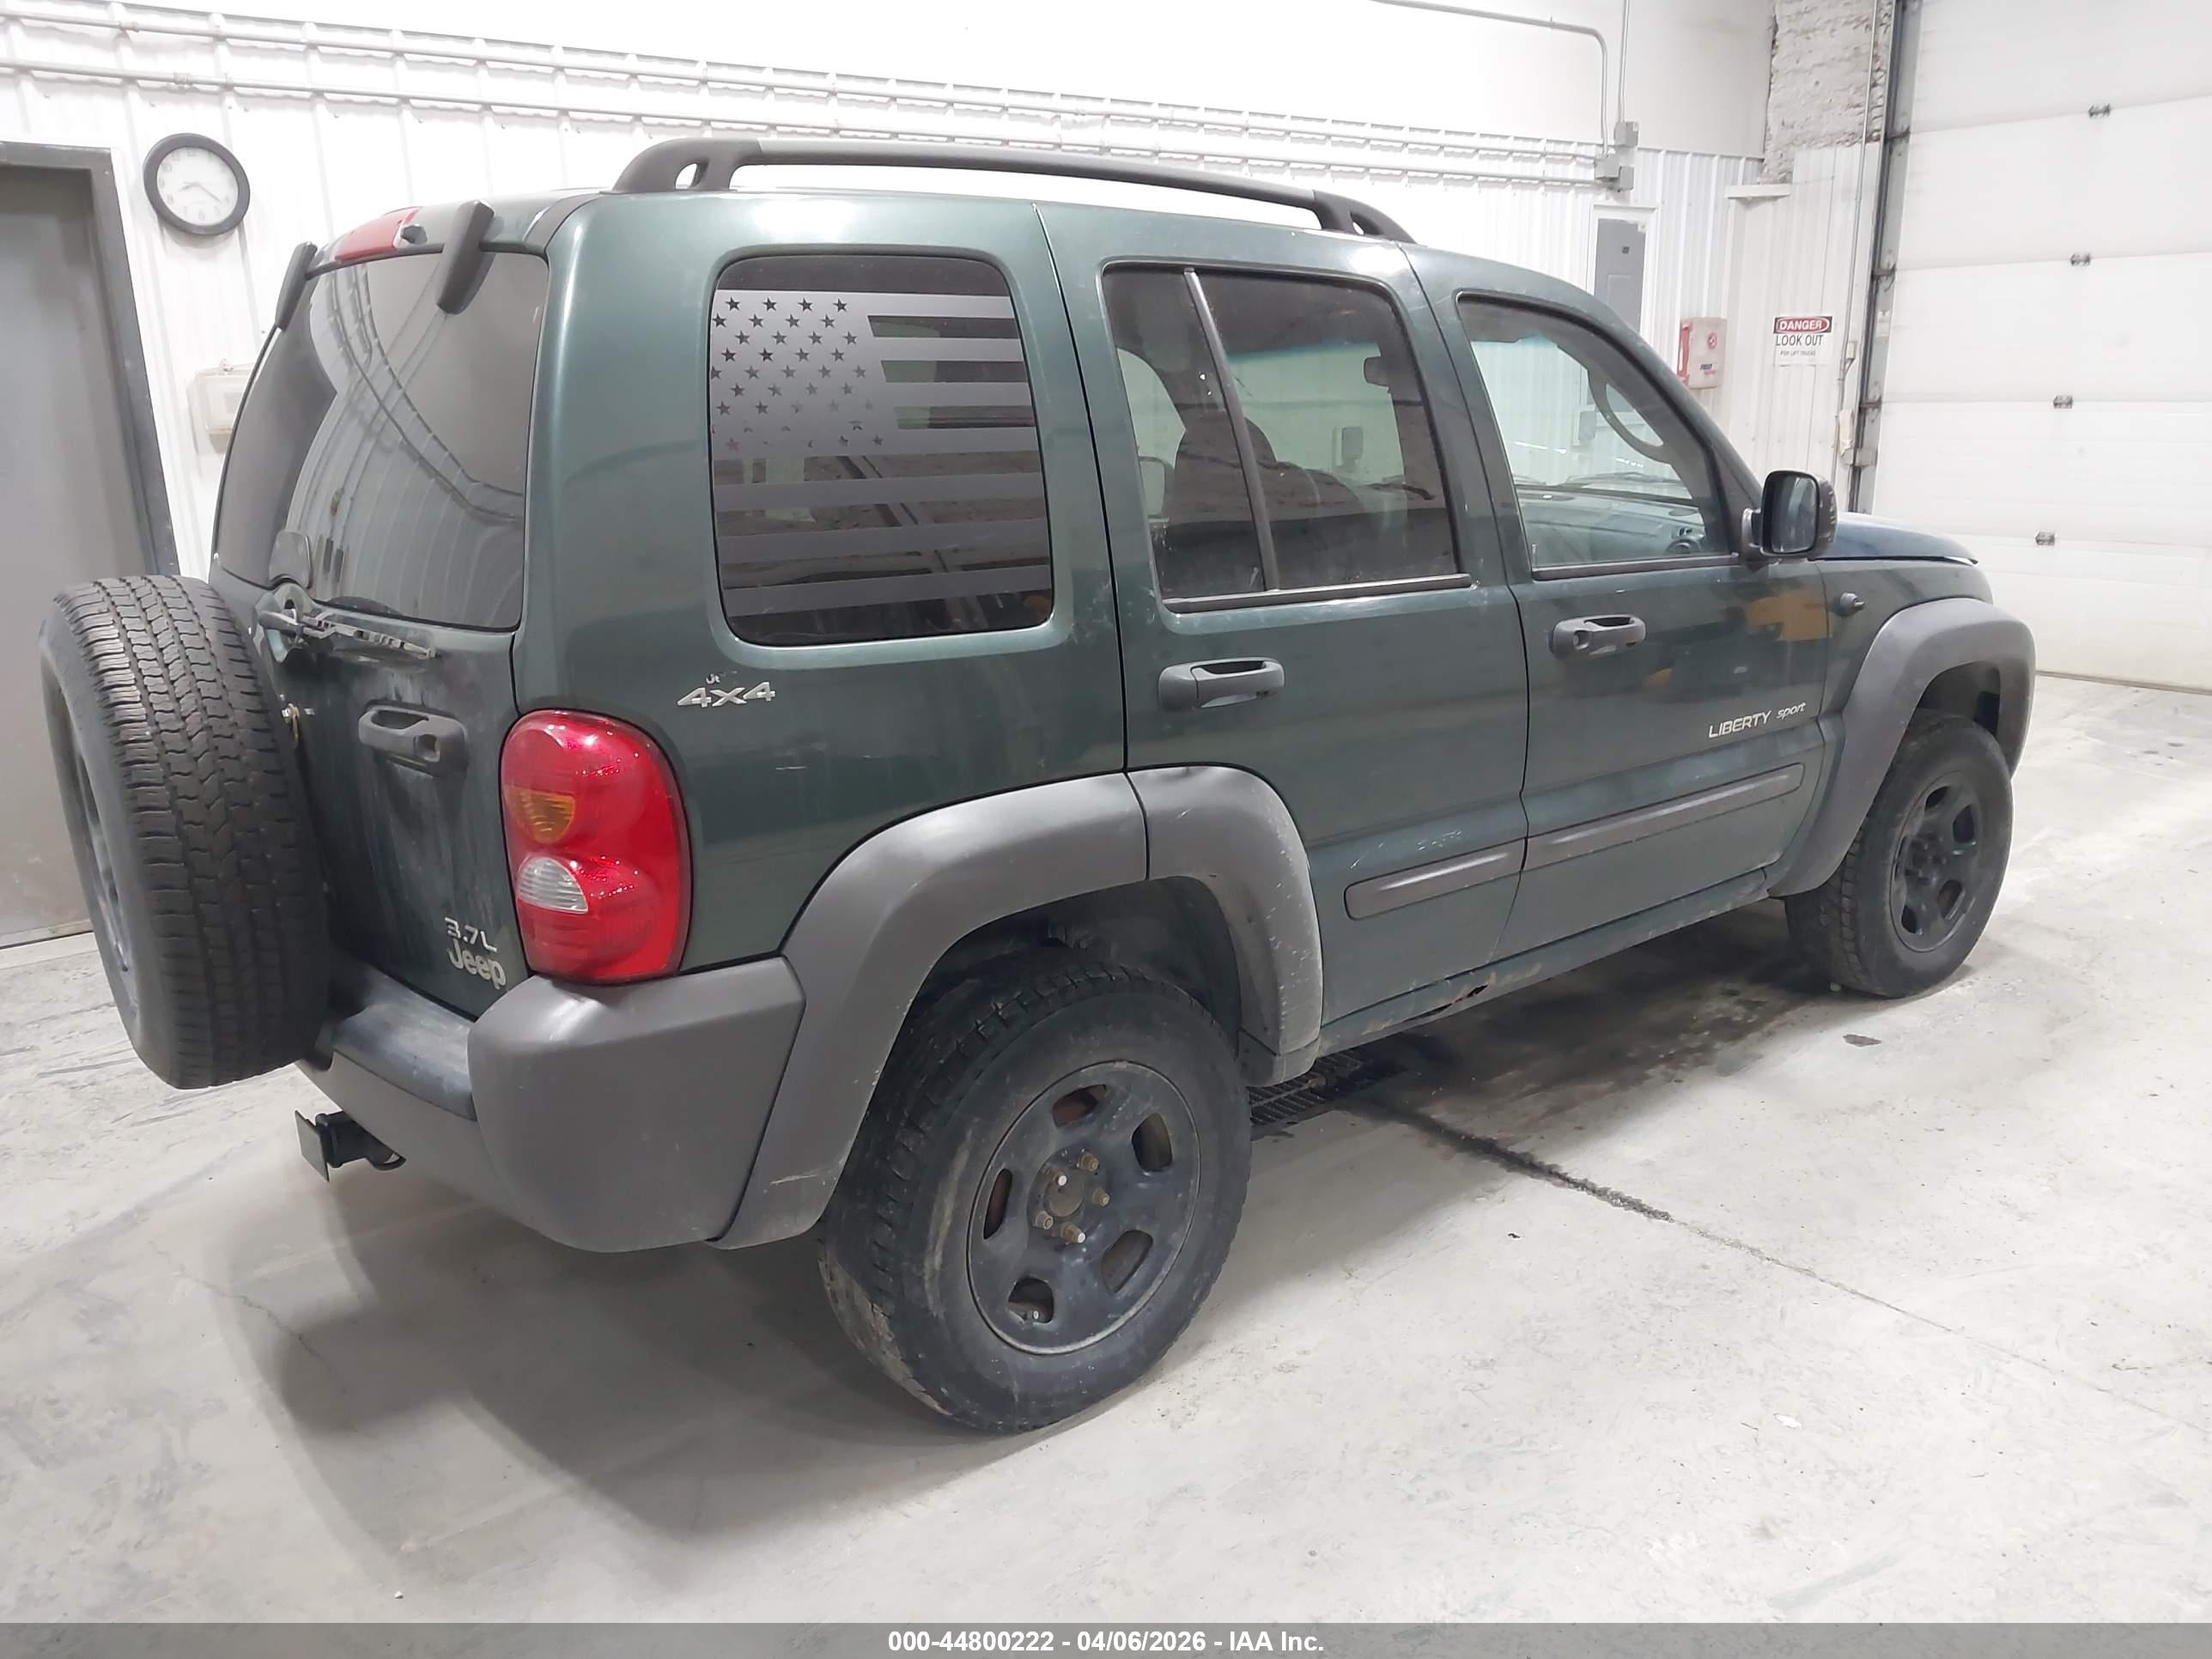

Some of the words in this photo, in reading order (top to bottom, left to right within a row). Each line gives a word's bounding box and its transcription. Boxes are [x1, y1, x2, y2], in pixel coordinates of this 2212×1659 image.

[1776, 335, 1802, 346] LOOK
[1805, 335, 1823, 346] OUT
[1779, 319, 1822, 331] DANGER
[1708, 709, 1772, 738] LIBERTY
[1776, 702, 1807, 720] sport
[445, 916, 498, 953] 3.7L
[447, 938, 507, 990] Jeep
